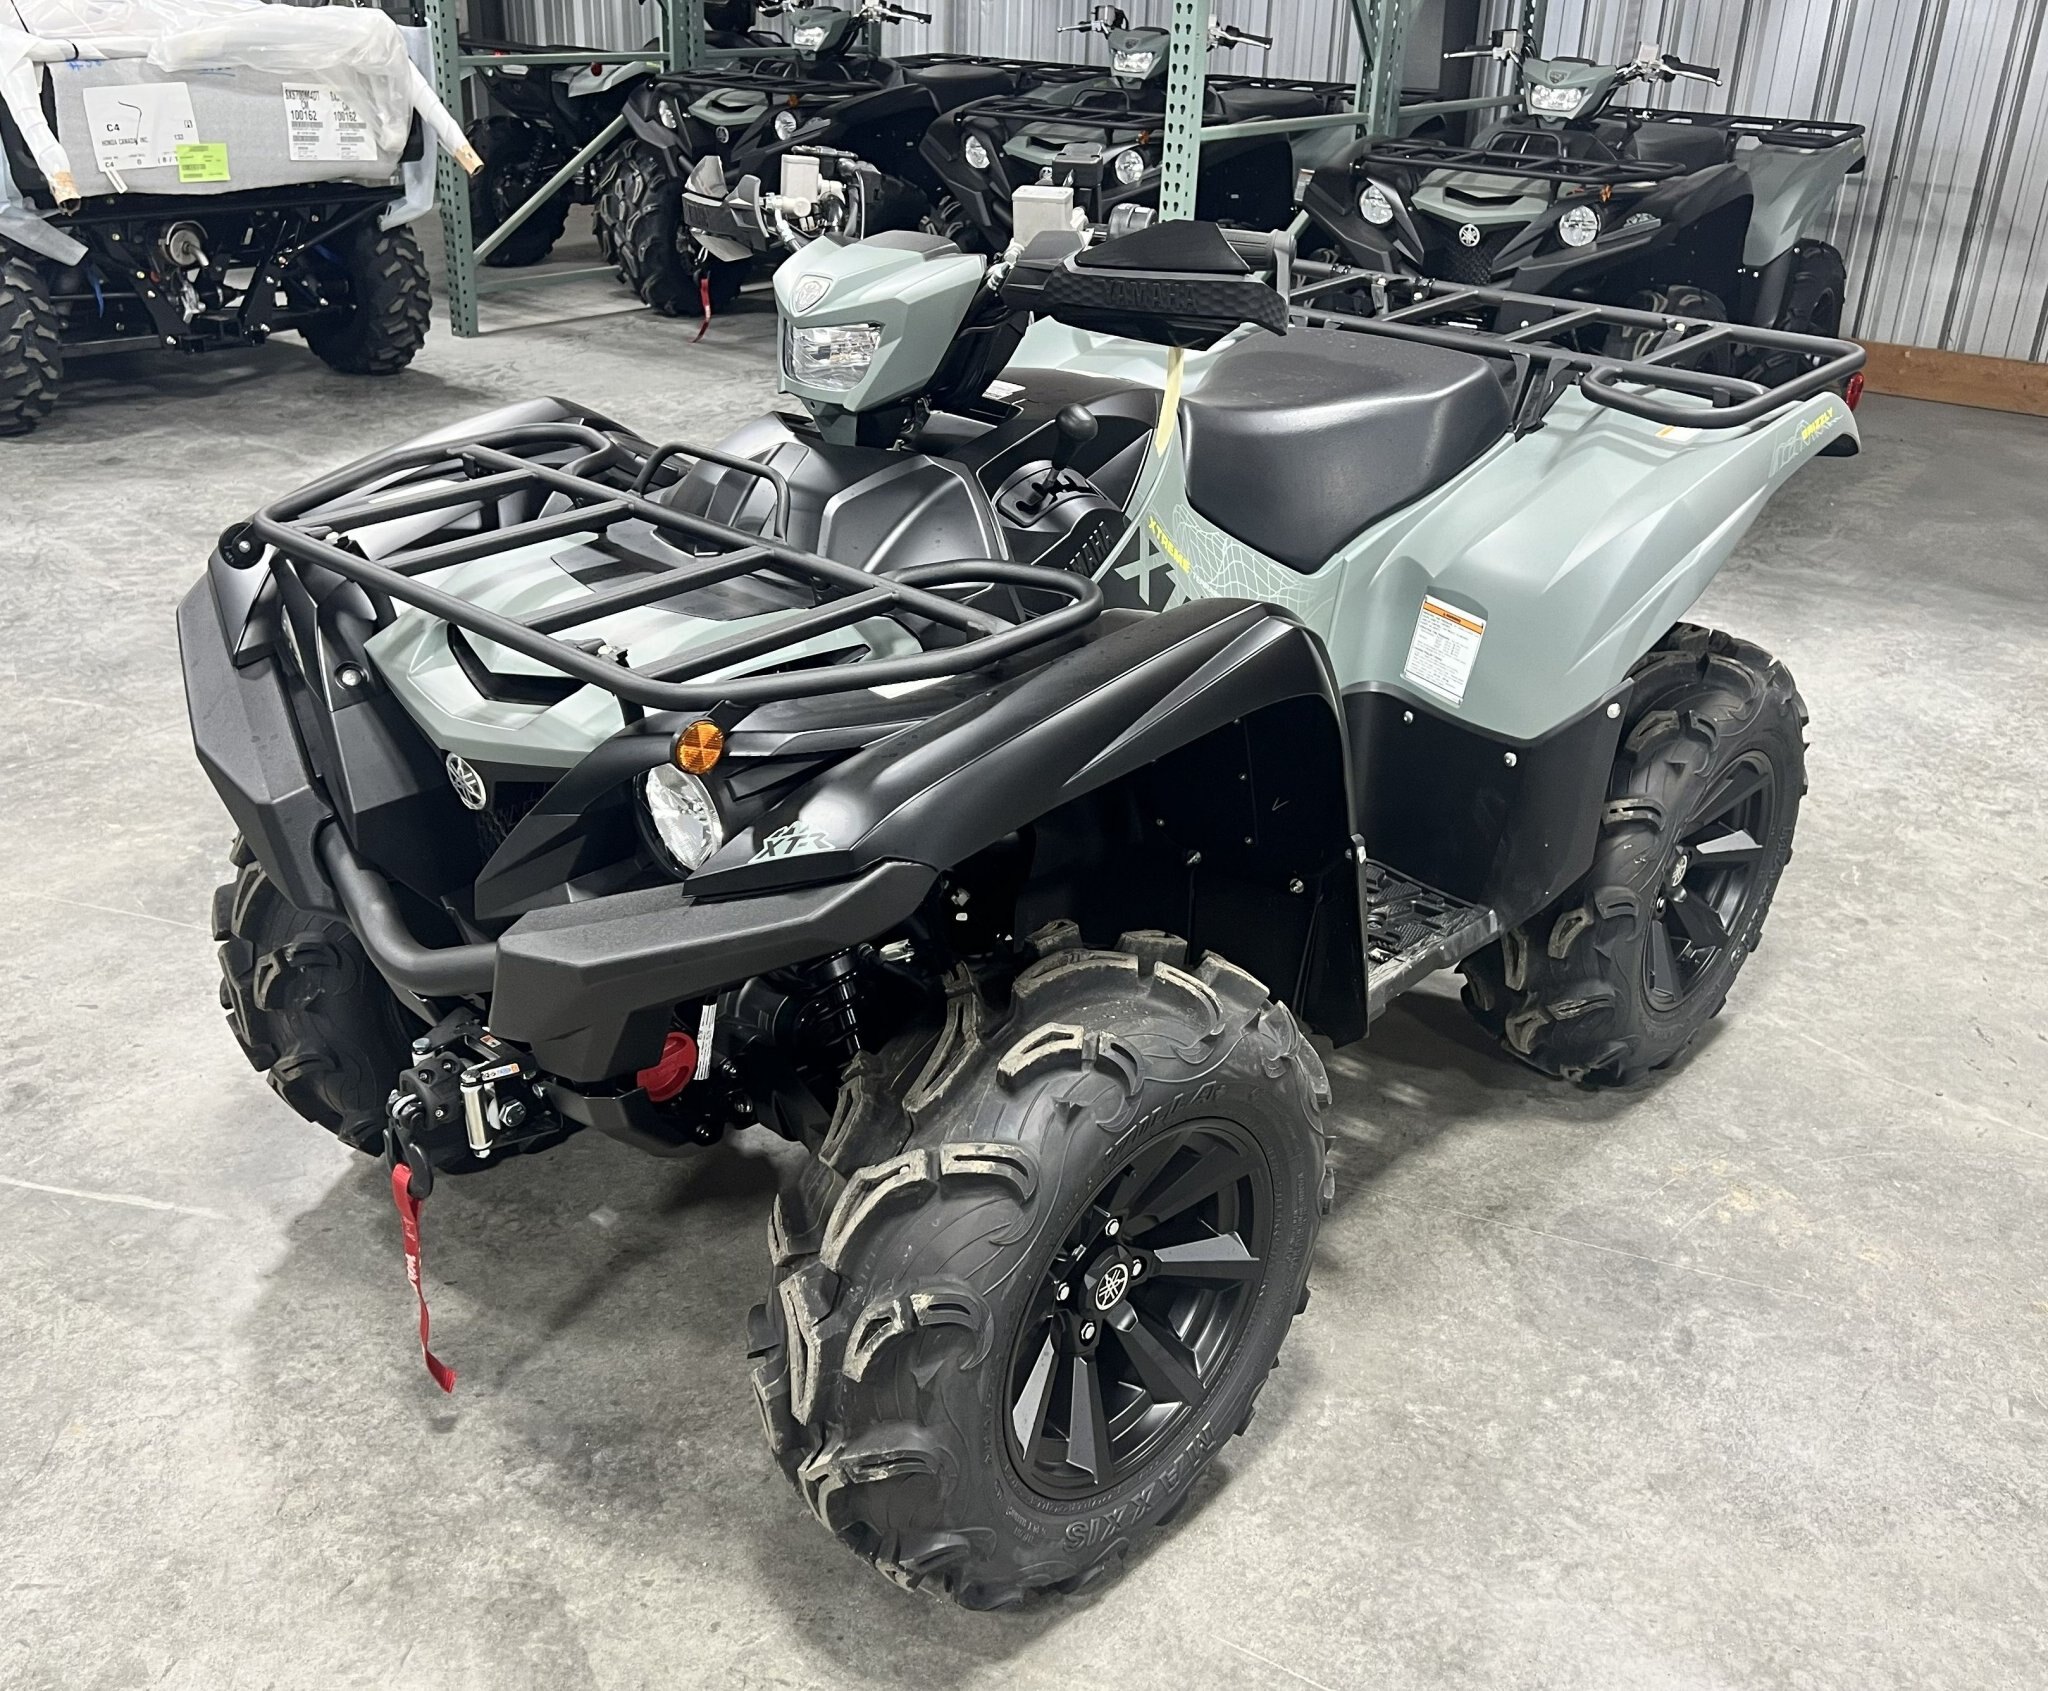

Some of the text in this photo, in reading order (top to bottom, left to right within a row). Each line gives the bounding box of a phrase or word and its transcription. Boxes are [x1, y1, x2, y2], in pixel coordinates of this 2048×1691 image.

[106, 123, 120, 132] C4
[291, 110, 317, 121] 100162
[1102, 279, 1199, 312] YAMAHA
[1148, 515, 1191, 575] XTREME
[752, 831, 835, 862] XT-R
[1063, 1421, 1219, 1551] MAXXIS
